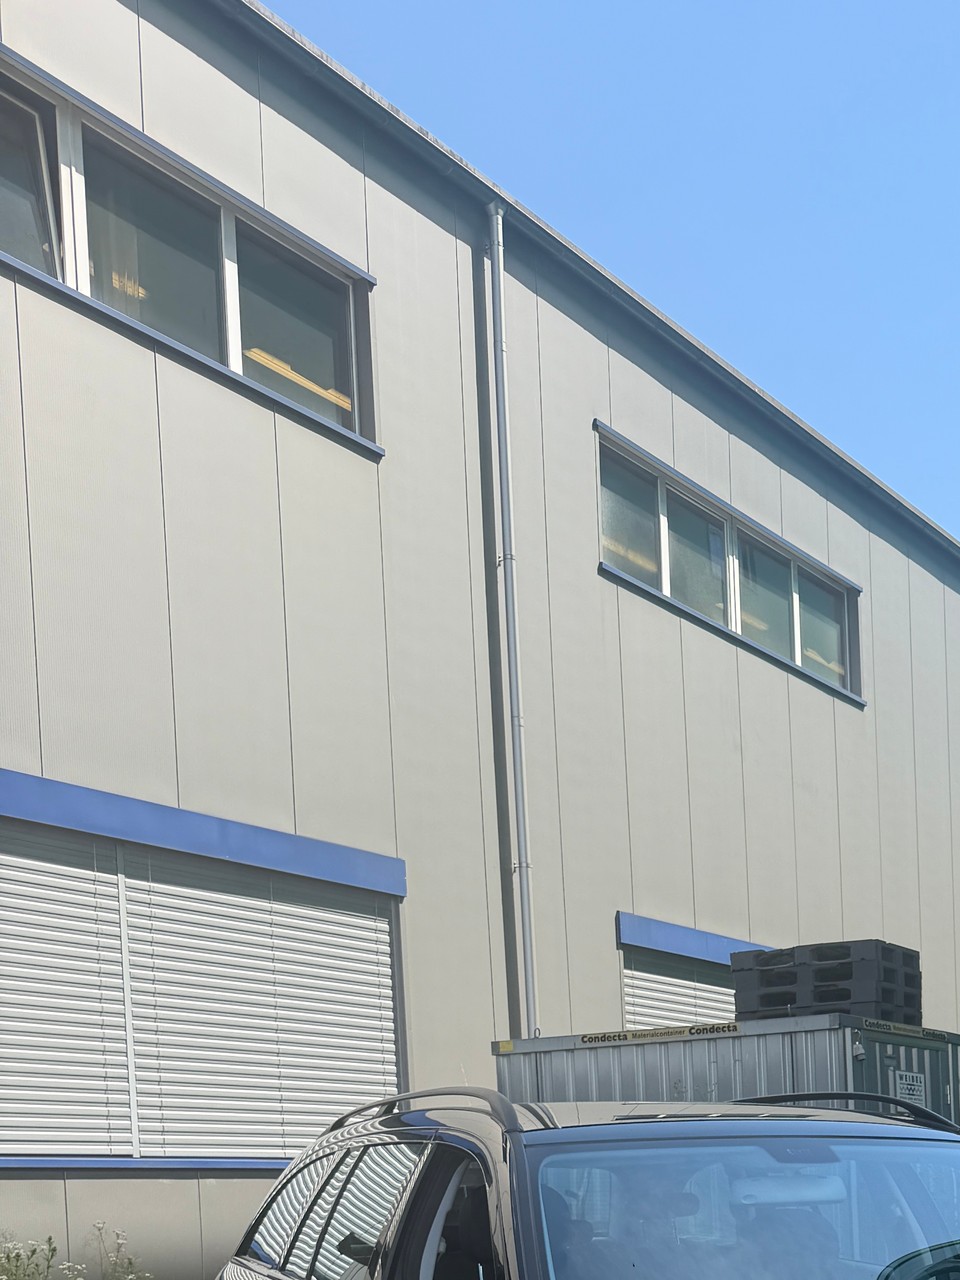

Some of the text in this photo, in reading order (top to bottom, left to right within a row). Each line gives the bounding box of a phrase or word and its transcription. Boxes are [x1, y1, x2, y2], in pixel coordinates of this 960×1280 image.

[864, 1019, 891, 1031] Condecta
[581, 1024, 738, 1044] Condecta Materialcontainer Condecta
[899, 1073, 923, 1084] WEIBEL
